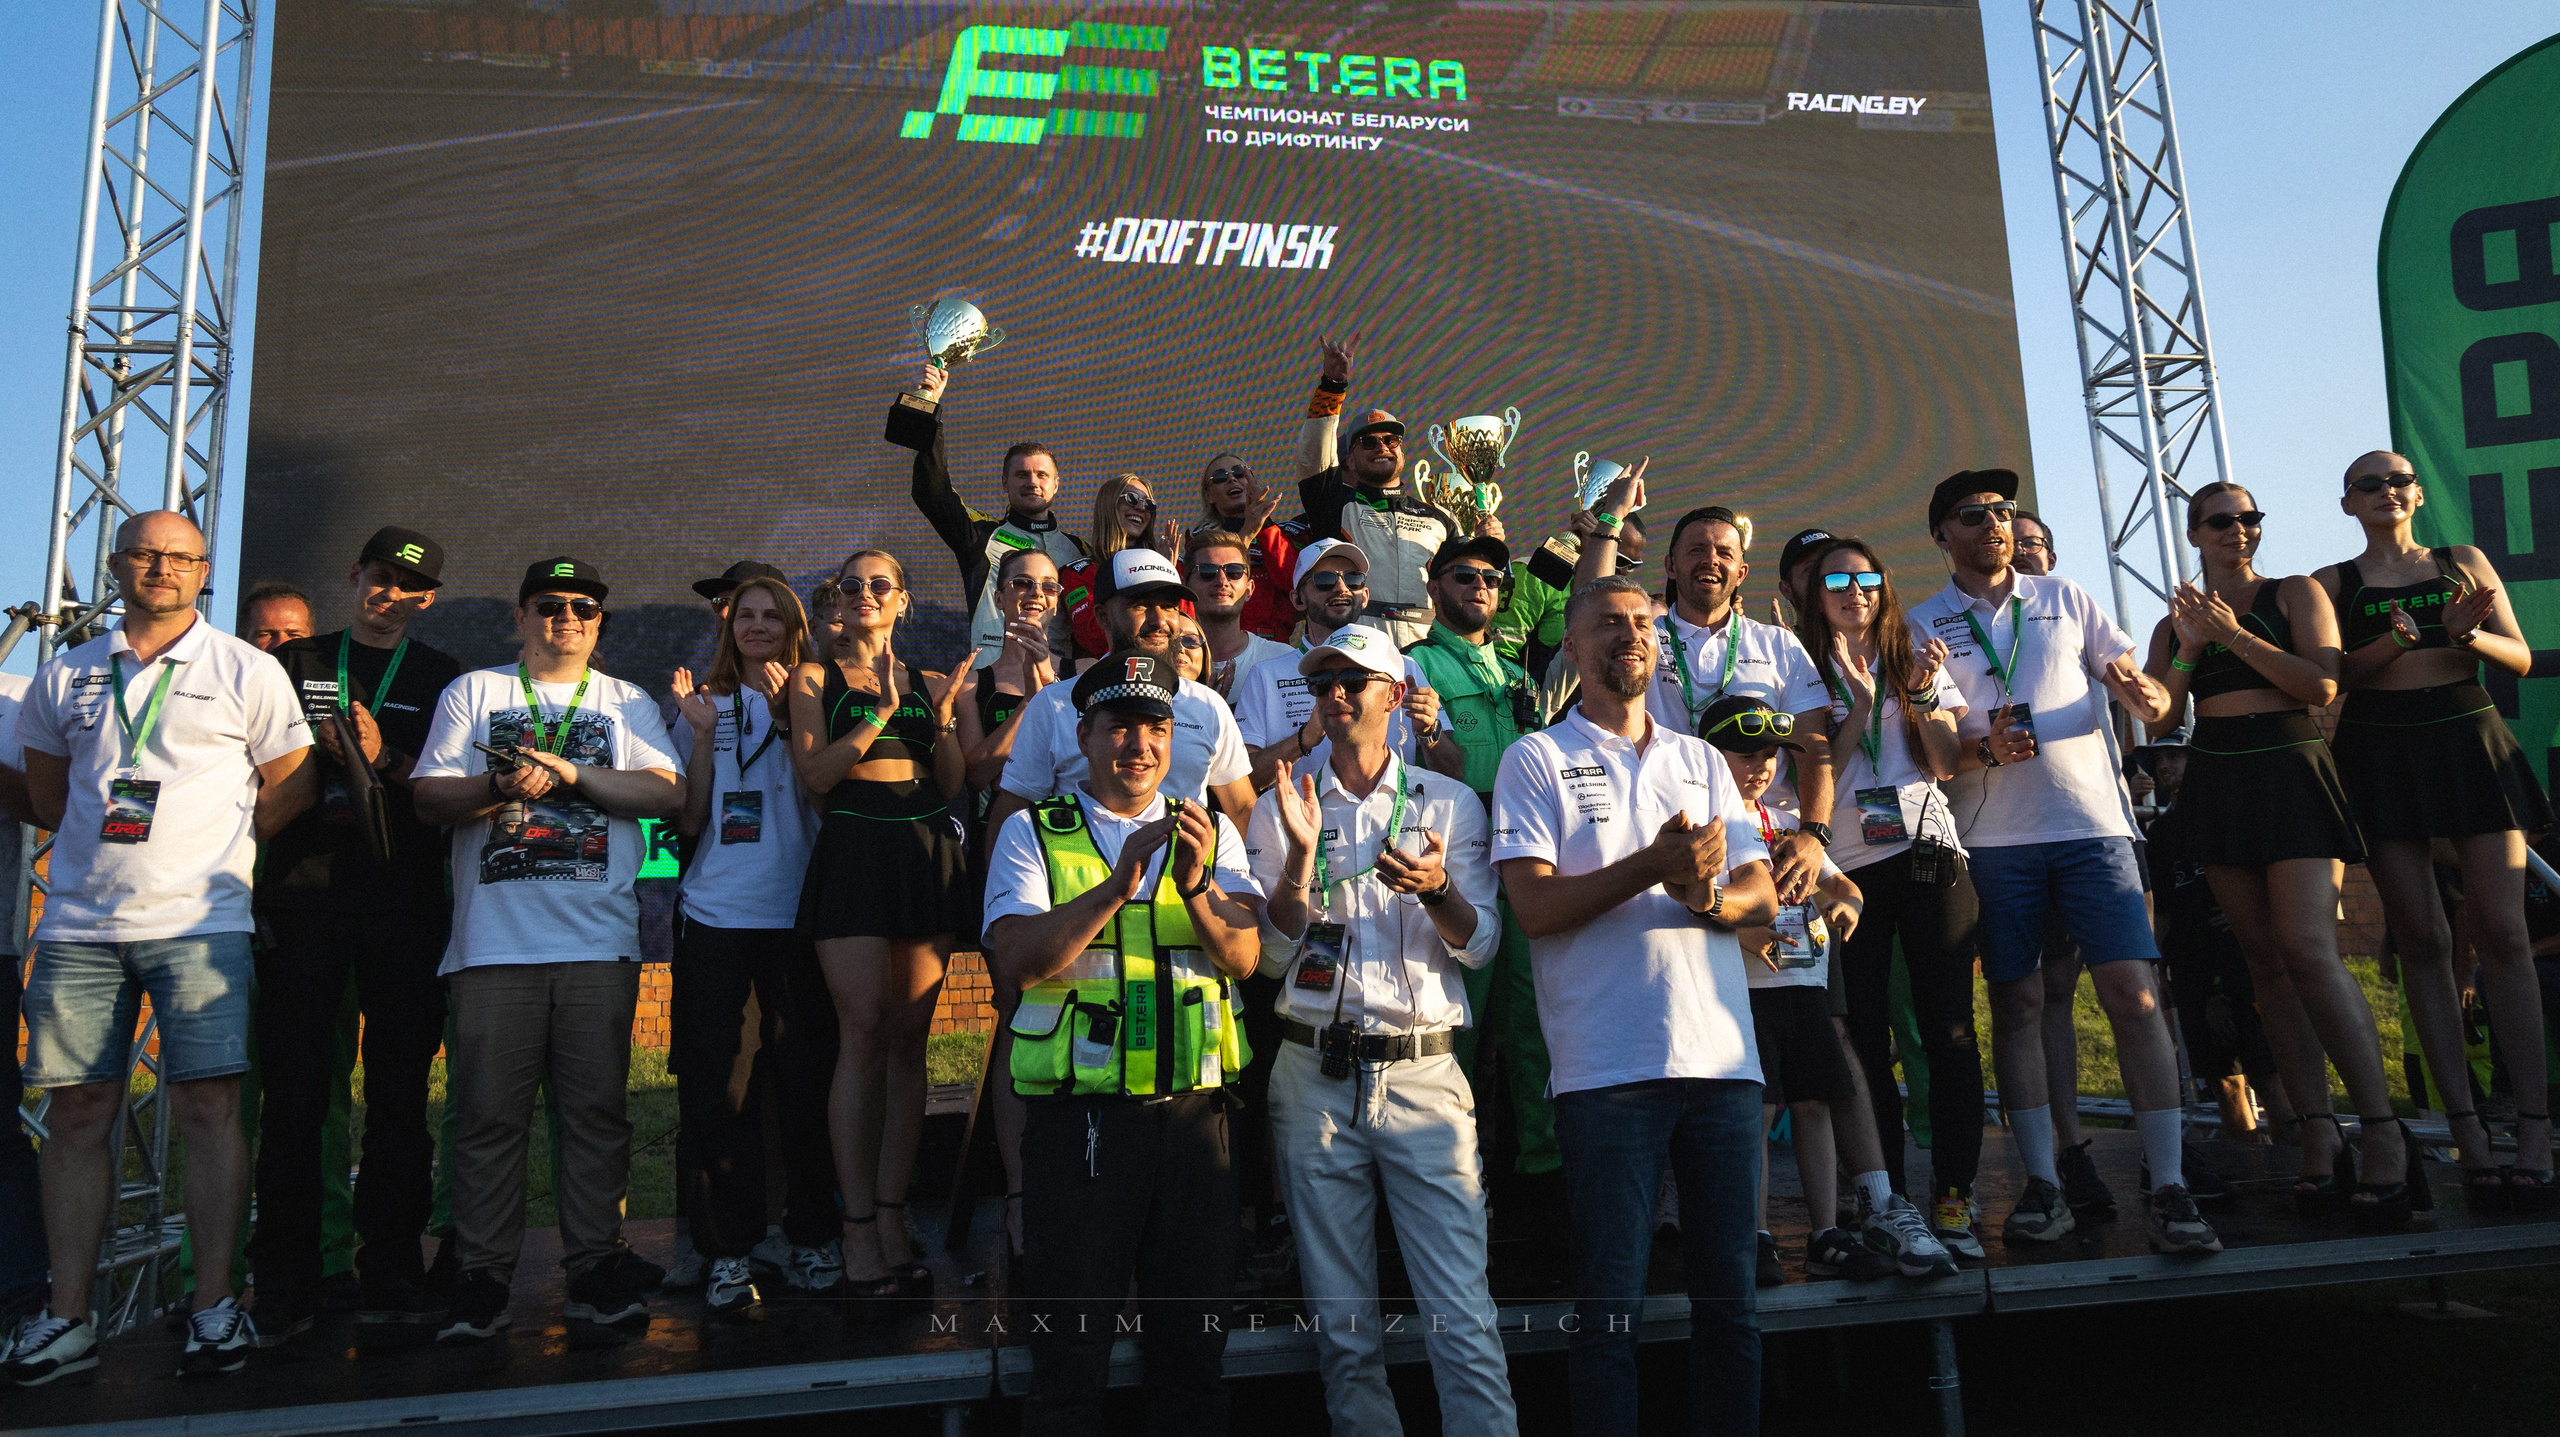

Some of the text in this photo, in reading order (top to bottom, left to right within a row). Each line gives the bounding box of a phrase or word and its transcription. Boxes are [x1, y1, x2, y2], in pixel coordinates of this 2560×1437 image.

[1787, 91, 1927, 116] RACING.BY
[1205, 104, 1470, 132] ЧЕМПИОНАТ БЕЛАРУСИ
[1206, 128, 1384, 151] ПО ДРИФТИНГУ
[1074, 216, 1340, 270] #DRIFTPINSK
[104, 822, 148, 835] ORG
[725, 828, 757, 838] ORG
[1867, 825, 1900, 839] ORG
[1300, 970, 1333, 983] ORG
